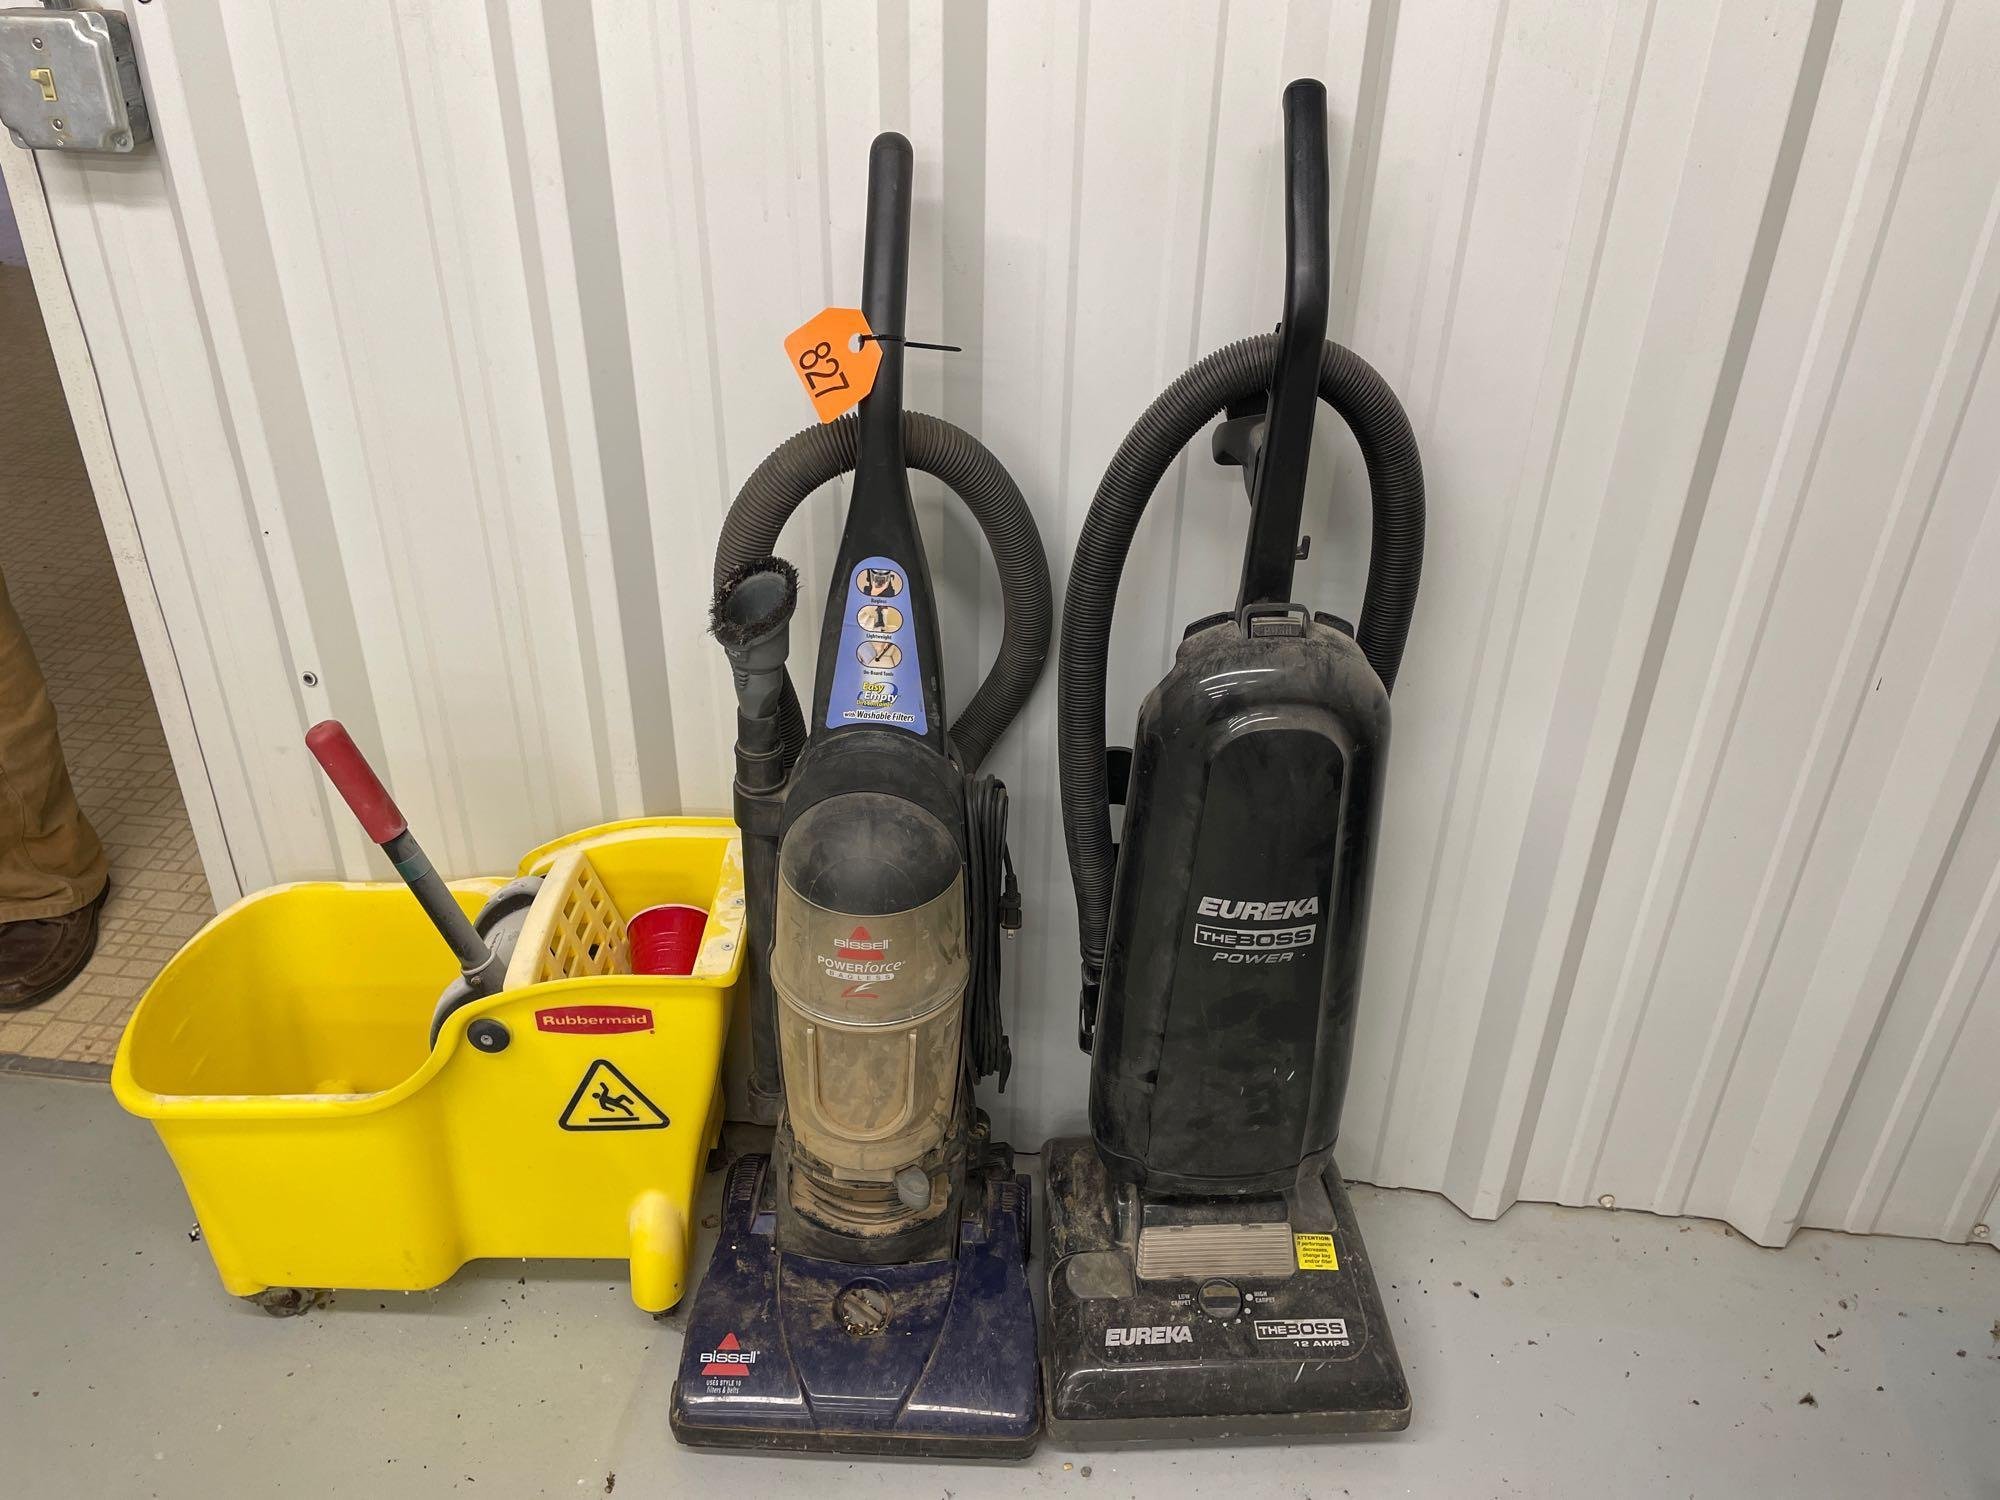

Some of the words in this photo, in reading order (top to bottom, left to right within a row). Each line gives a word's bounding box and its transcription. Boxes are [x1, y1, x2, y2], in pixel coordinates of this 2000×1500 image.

[799, 341, 850, 399] 827
[863, 682, 885, 694] Easy
[864, 691, 898, 704] Empty
[857, 710, 892, 720] Washable
[892, 713, 914, 722] Filters
[1197, 896, 1319, 921] EUREKA
[1212, 952, 1294, 964] POWER
[829, 970, 891, 981] BAGLESS
[542, 1014, 648, 1026] Rubbermaid
[1105, 1325, 1193, 1347] EUREKA
[720, 1379, 734, 1387] STYLE
